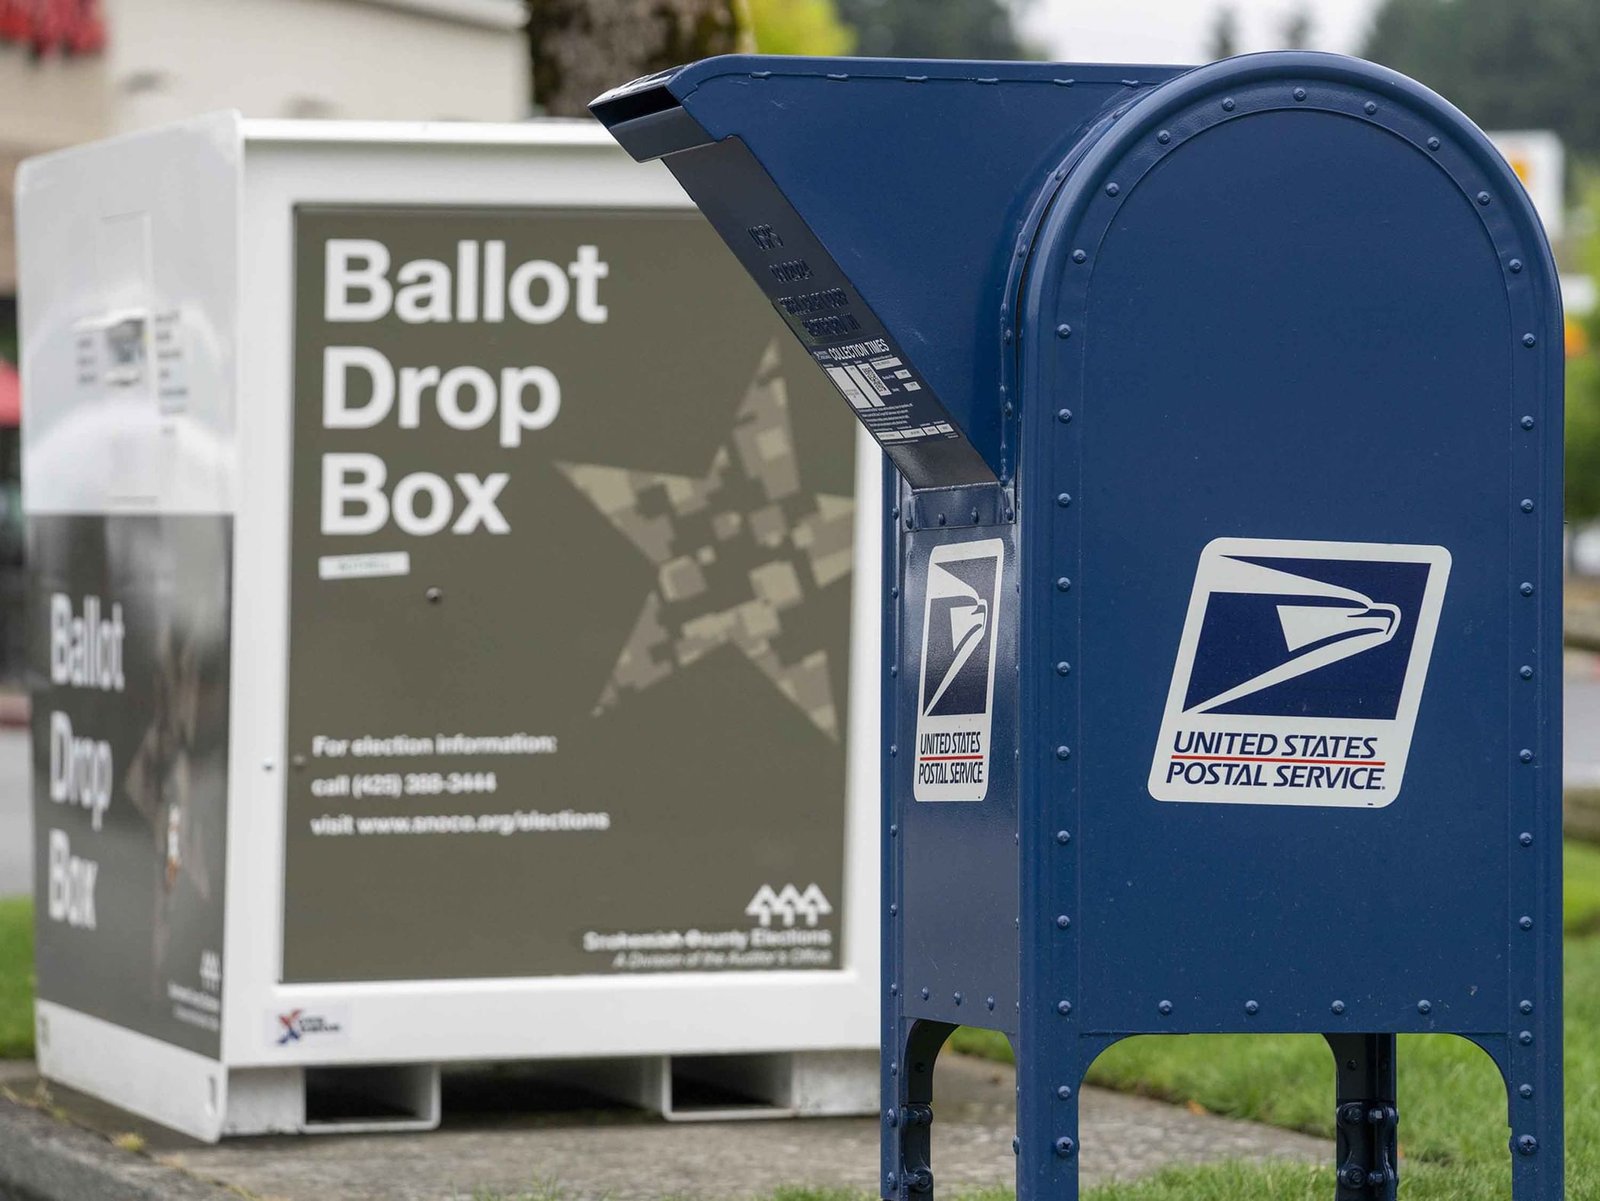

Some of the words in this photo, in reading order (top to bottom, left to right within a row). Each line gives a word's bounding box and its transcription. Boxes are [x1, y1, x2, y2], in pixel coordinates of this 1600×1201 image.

[324, 238, 609, 324] Ballot
[828, 342, 870, 361] COLLECTION
[864, 338, 889, 354] TIMES
[322, 345, 561, 448] Drop
[320, 452, 511, 536] Box
[50, 592, 125, 692] Ballot
[312, 735, 348, 757] For
[351, 734, 434, 757] election
[920, 732, 951, 755] UNITED
[951, 731, 981, 754] STATES
[1172, 731, 1279, 756] UNITED
[1280, 734, 1378, 759] STATES
[50, 710, 113, 832] Drop
[918, 762, 949, 785] POSTAL
[949, 761, 984, 784] SERVICE
[1166, 761, 1268, 787] POSTAL
[311, 775, 350, 797] call
[310, 813, 355, 836] visit
[48, 827, 98, 930] Box
[749, 927, 832, 948] Elections
